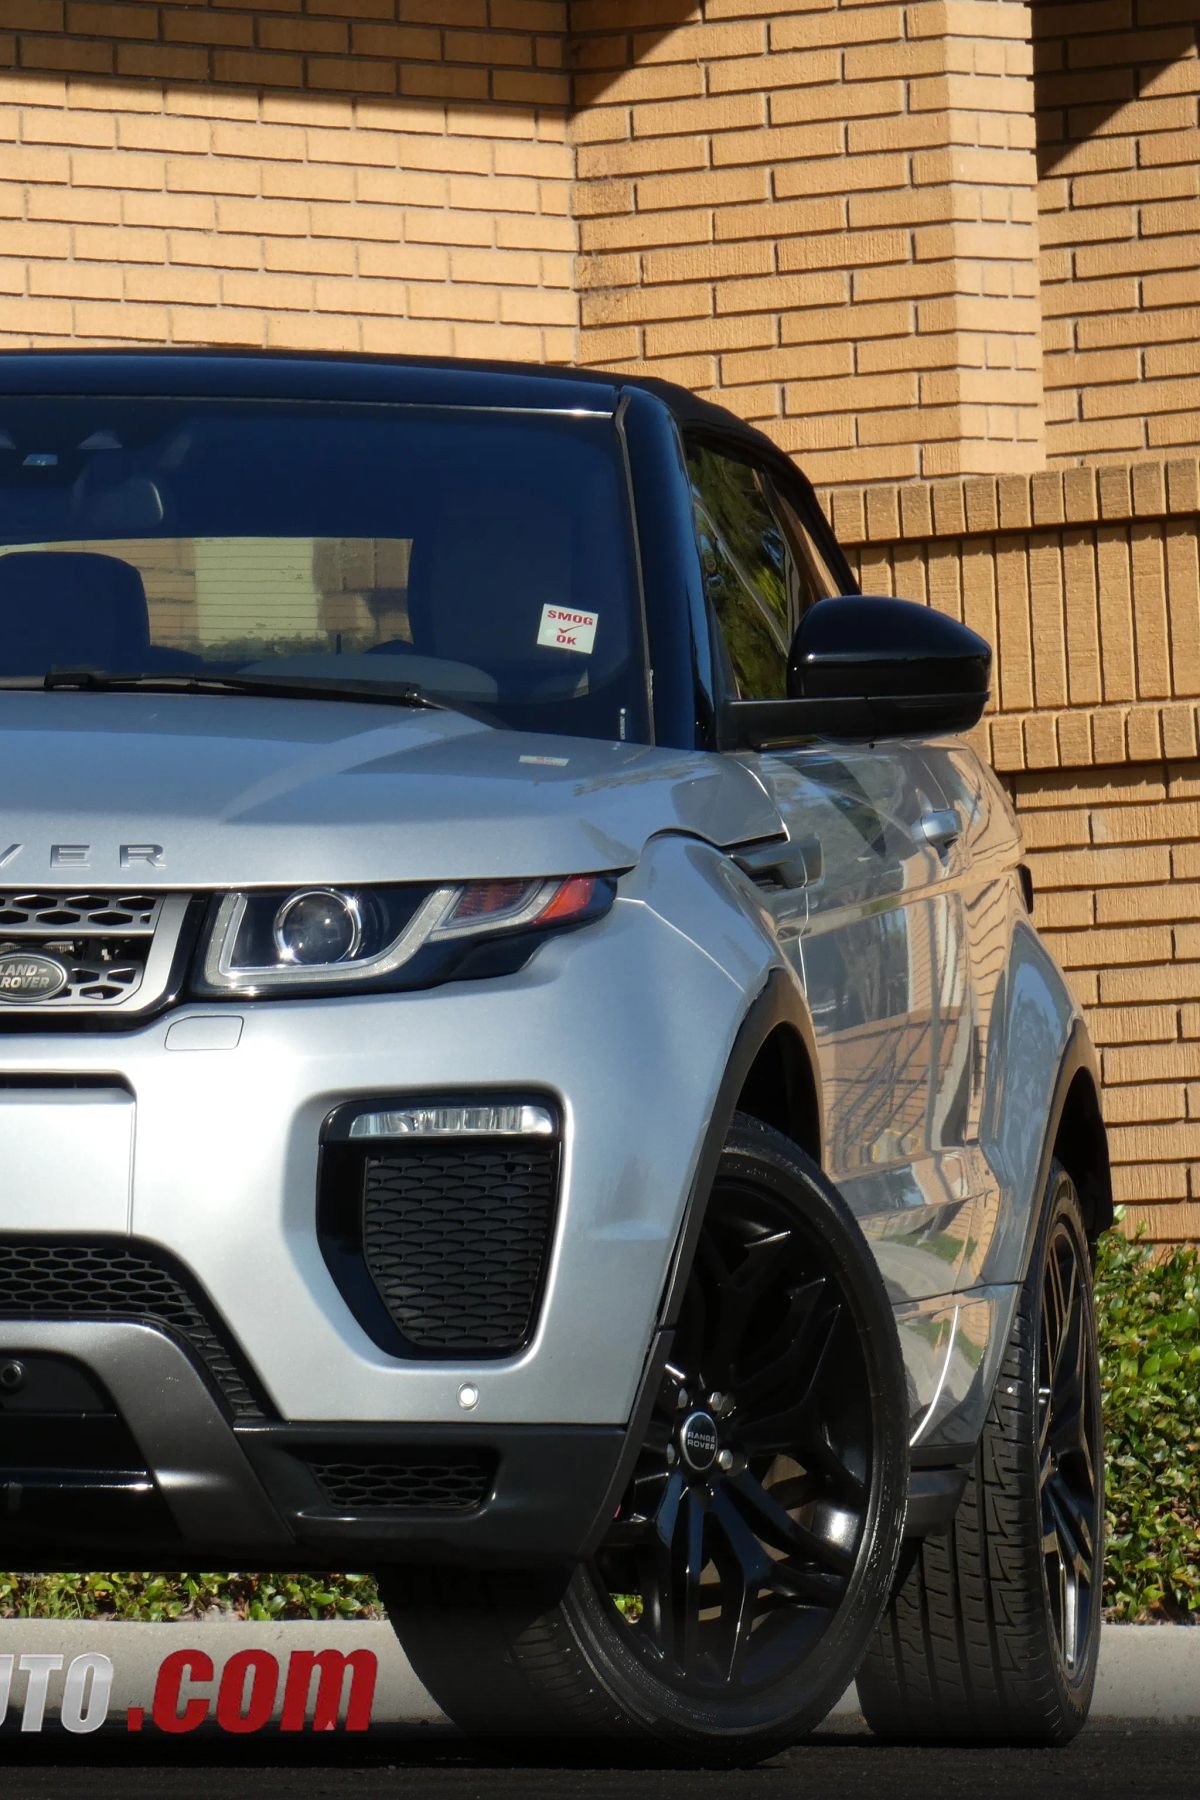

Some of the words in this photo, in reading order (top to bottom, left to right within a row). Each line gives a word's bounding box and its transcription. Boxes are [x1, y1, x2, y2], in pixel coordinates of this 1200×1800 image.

[547, 609, 593, 625] SMOG
[556, 634, 576, 645] OK
[687, 1431, 715, 1443] RANGE
[687, 1439, 715, 1450] ROVER
